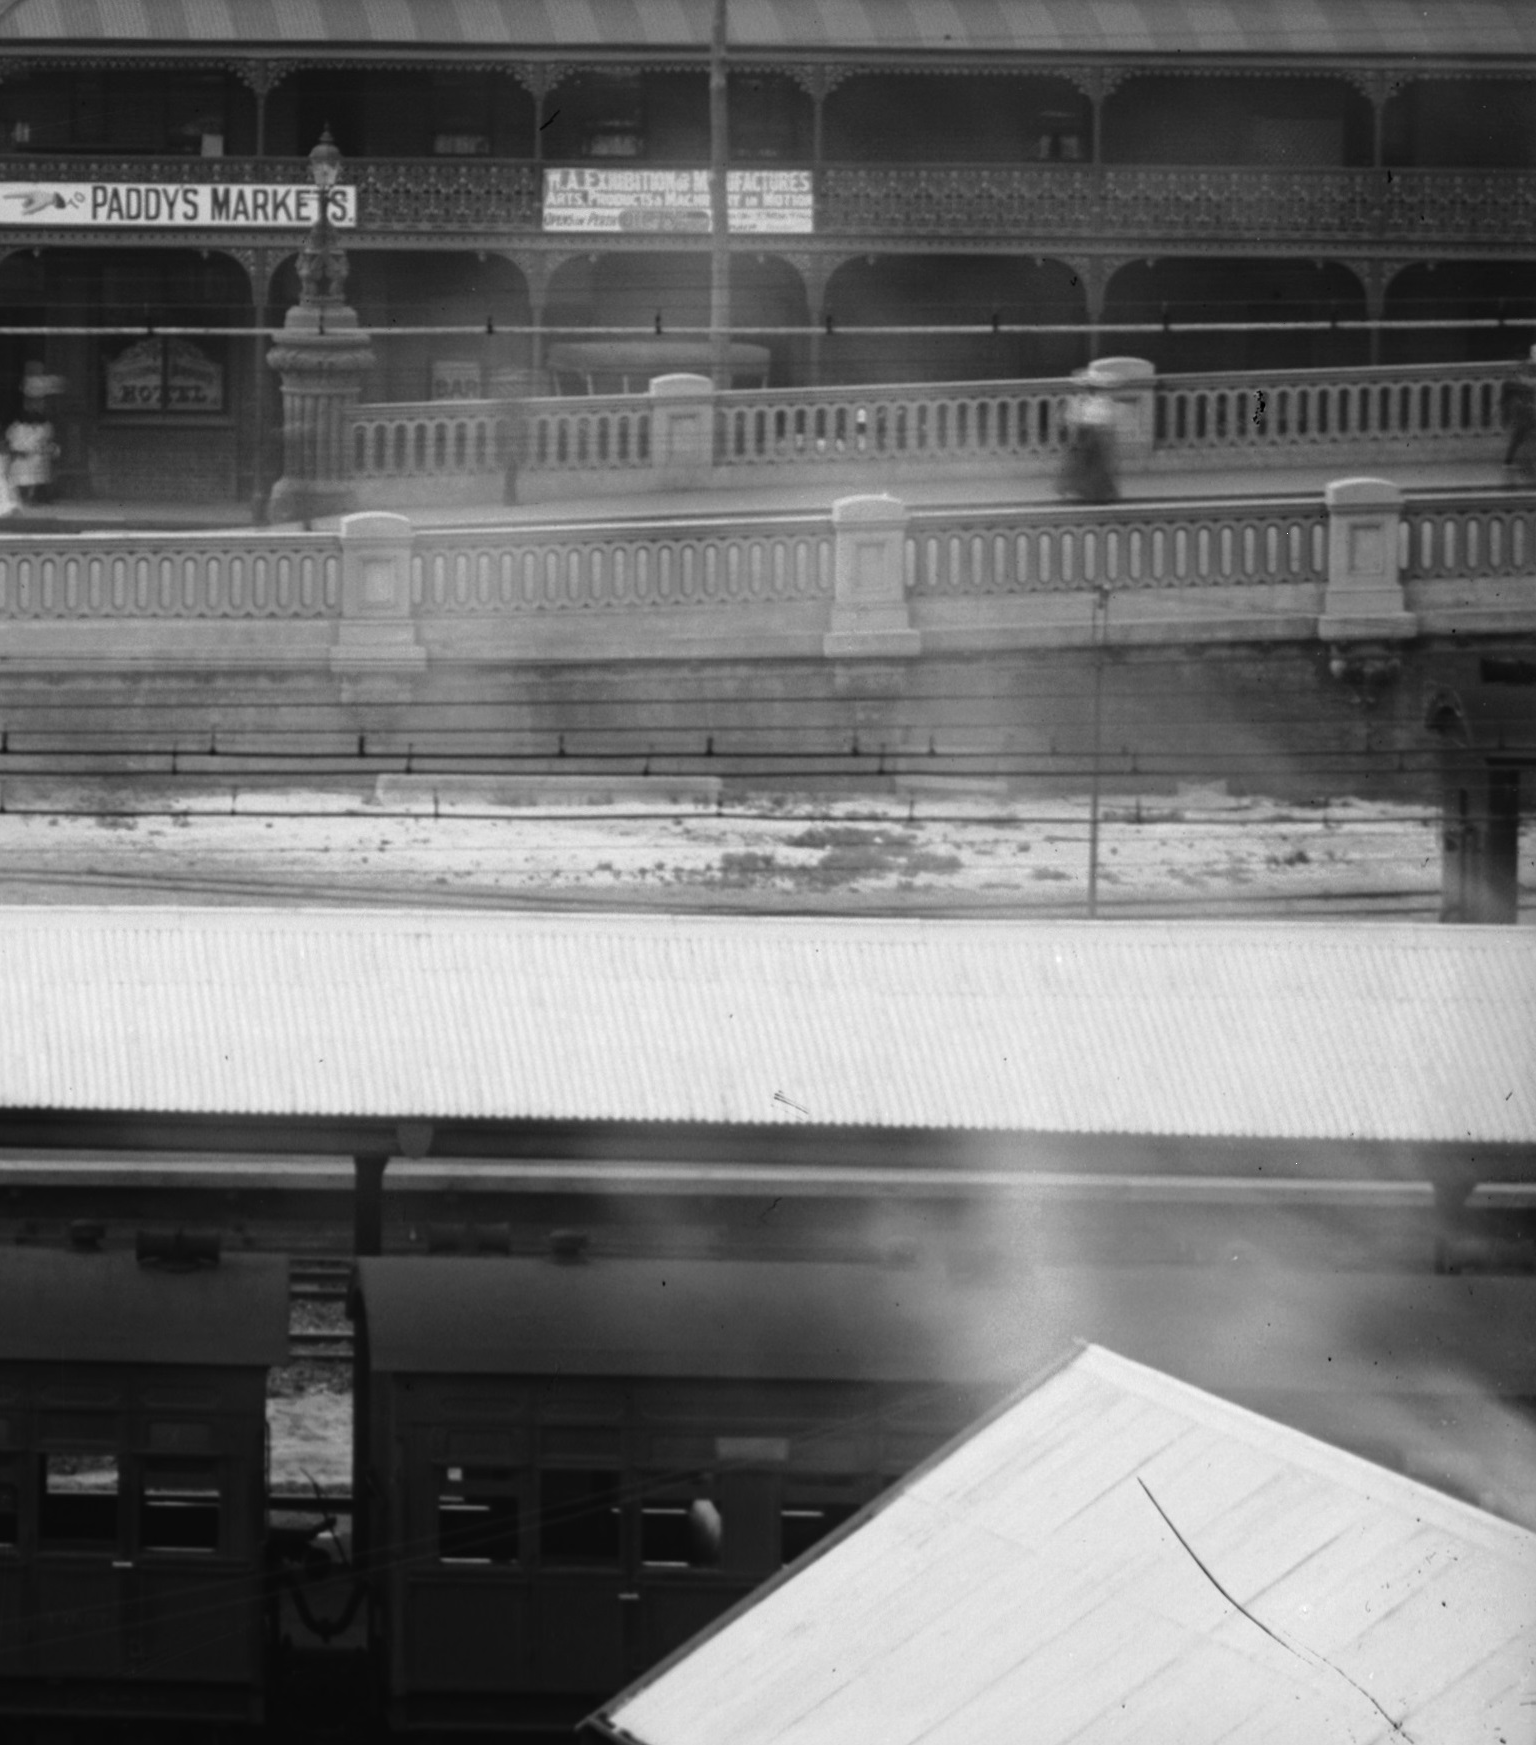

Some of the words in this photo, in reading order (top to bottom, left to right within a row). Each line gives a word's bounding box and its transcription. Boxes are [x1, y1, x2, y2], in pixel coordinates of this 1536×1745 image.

[586, 171, 675, 192] EXHIBITION
[91, 185, 200, 221] PADDY'S
[587, 189, 654, 207] PRODUCTS
[762, 193, 813, 208] MOTION
